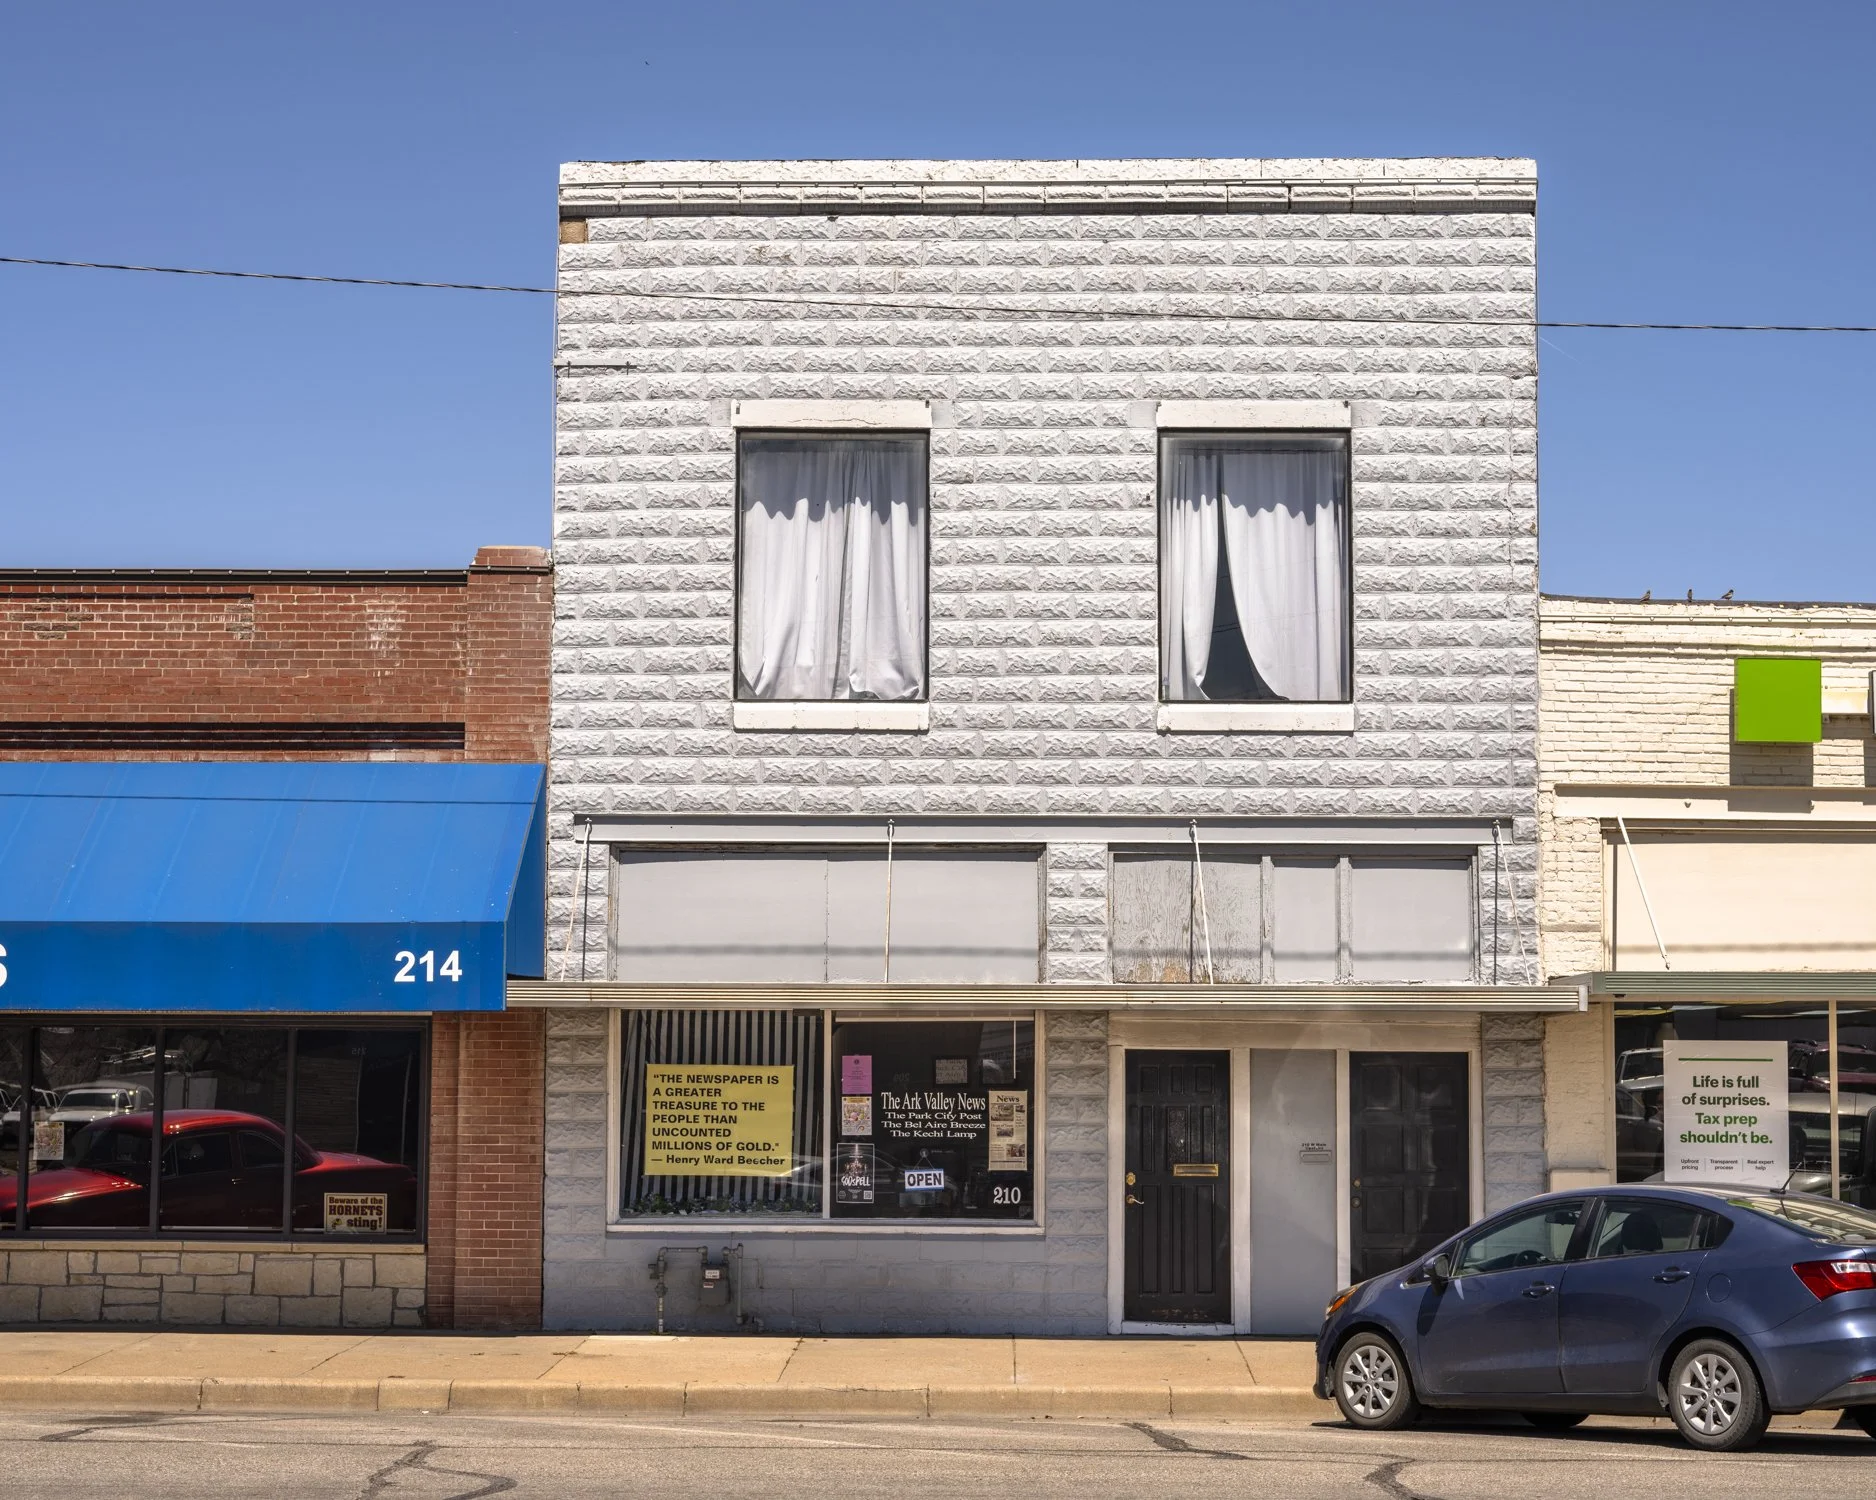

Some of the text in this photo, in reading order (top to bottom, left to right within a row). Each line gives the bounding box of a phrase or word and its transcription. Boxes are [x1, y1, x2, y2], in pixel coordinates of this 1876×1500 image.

[394, 950, 462, 982] 214
[654, 1074, 779, 1084] "THE NEWSPAPER IS
[1692, 1075, 1759, 1088] Life is full
[653, 1088, 722, 1097] A GREATER
[653, 1101, 765, 1111] TREASURE TO THE
[881, 1092, 986, 1113] The Ark Valley News
[1682, 1092, 1770, 1108] of surprises.
[653, 1114, 737, 1124] PEOPLE THAN
[934, 1112, 956, 1121] City
[1695, 1112, 1757, 1127] Tax prep
[652, 1128, 731, 1137] UNCOUNTED
[1680, 1131, 1773, 1144] shouldn't be.
[652, 1141, 779, 1151] MILLIONS OF GOLD."
[666, 1155, 700, 1166] Henry
[704, 1155, 733, 1164] Ward
[738, 1156, 785, 1165] Beecher
[907, 1173, 942, 1187] OPEN
[993, 1187, 1021, 1204] 210
[329, 1205, 383, 1216] HORNETS
[347, 1217, 382, 1230] sting!
